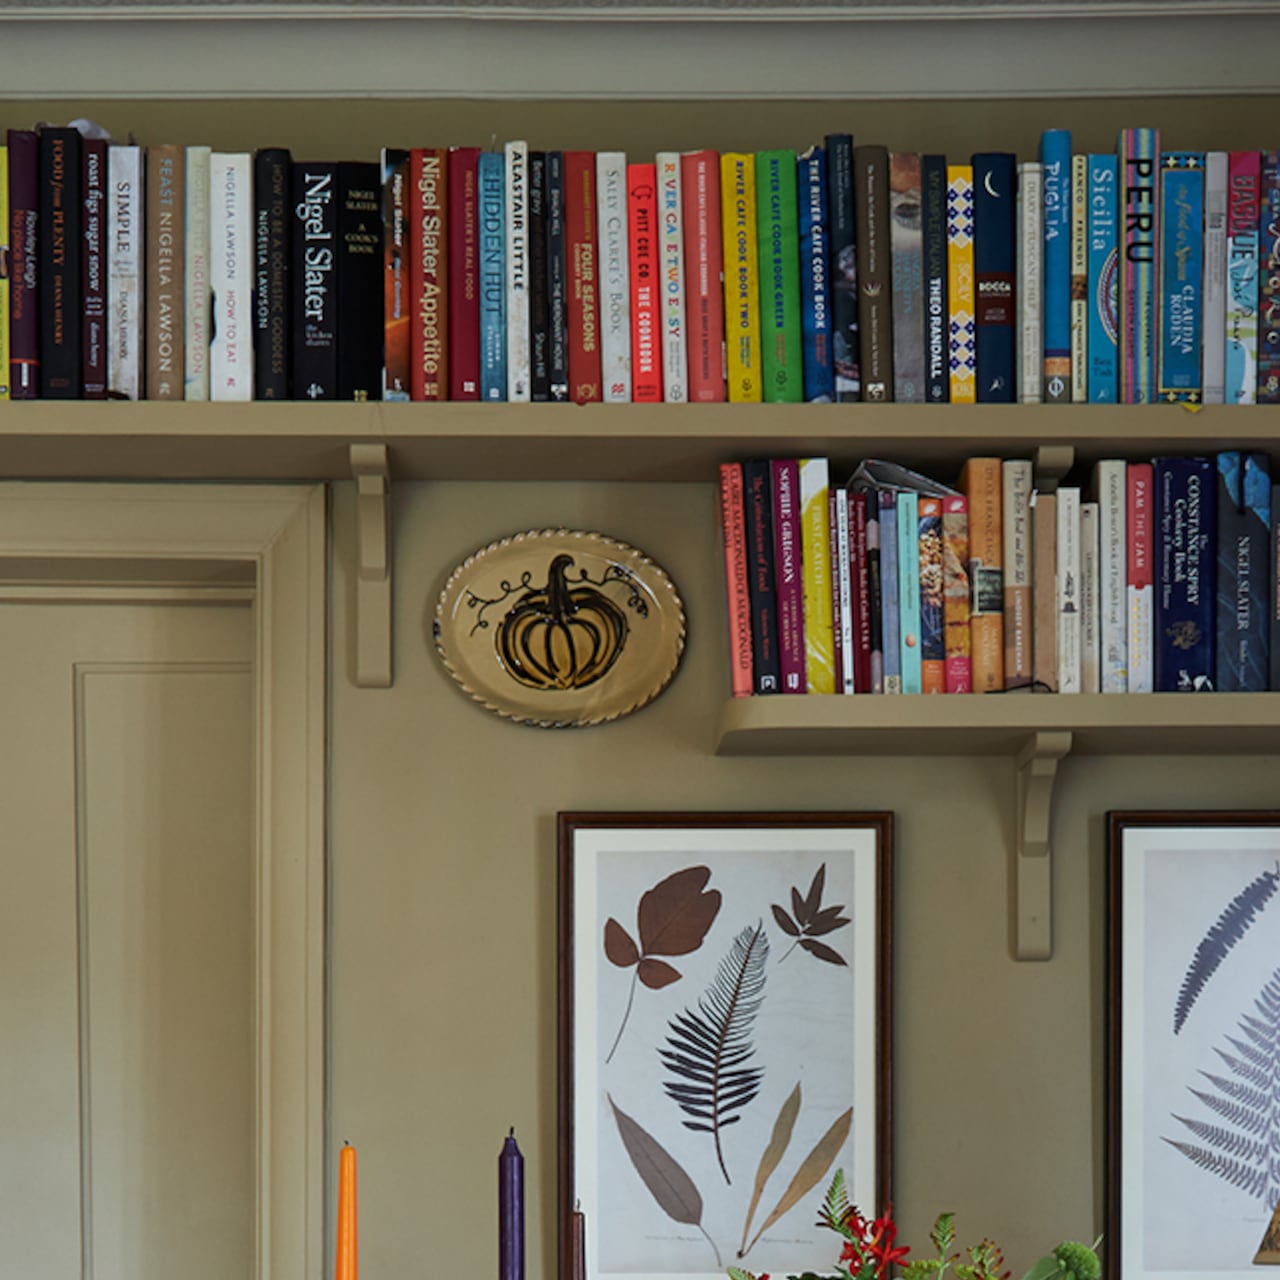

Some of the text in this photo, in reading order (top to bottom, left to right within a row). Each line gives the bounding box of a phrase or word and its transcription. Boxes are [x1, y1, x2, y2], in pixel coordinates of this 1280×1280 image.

[84, 153, 102, 291] roast figs sugar snow
[116, 182, 130, 252] SIMPLE
[226, 166, 236, 280] NIGELLA LAWSON
[392, 173, 403, 247] Nigel Slater
[512, 151, 524, 292] ALASTAIR LITTLE
[530, 160, 542, 216] Better gravy
[1044, 161, 1060, 242] PUGLIA
[1092, 168, 1114, 252] Sicilia
[1126, 158, 1154, 264] PERU
[1231, 174, 1256, 260] BASQUE
[12, 209, 25, 320] No place like home
[158, 158, 173, 372] FEAST NIGELLA LAWSON
[258, 210, 268, 329] NIGELLA LAWSON
[295, 173, 333, 322] Nigel Slater
[348, 244, 375, 254] BOOK
[418, 156, 443, 374] Nigel Slater Appetite
[735, 160, 750, 329] RIVER CAFE COOK BOOK TWO
[808, 159, 825, 330] THE RIVER CAFE COOK BOOK
[193, 255, 204, 374] NIGELLA LAWSON
[226, 290, 236, 364] HOW TO EAT
[580, 243, 595, 352] FOUR SEASONS
[929, 278, 943, 379] THEO RANDALL
[1170, 294, 1184, 347] RODEN
[1182, 285, 1196, 355] CLAUDIA
[534, 332, 545, 378] Shaun Hill
[778, 467, 796, 583] SOPHIE GRIGSON
[1134, 481, 1146, 569] PAM THE JAM
[1169, 498, 1186, 583] Cookery Book
[1186, 474, 1202, 606] CONSTANCE SPRY
[1014, 590, 1024, 672] LINDSEY BAREHAM
[1237, 536, 1250, 630] NIGEL SLATER
